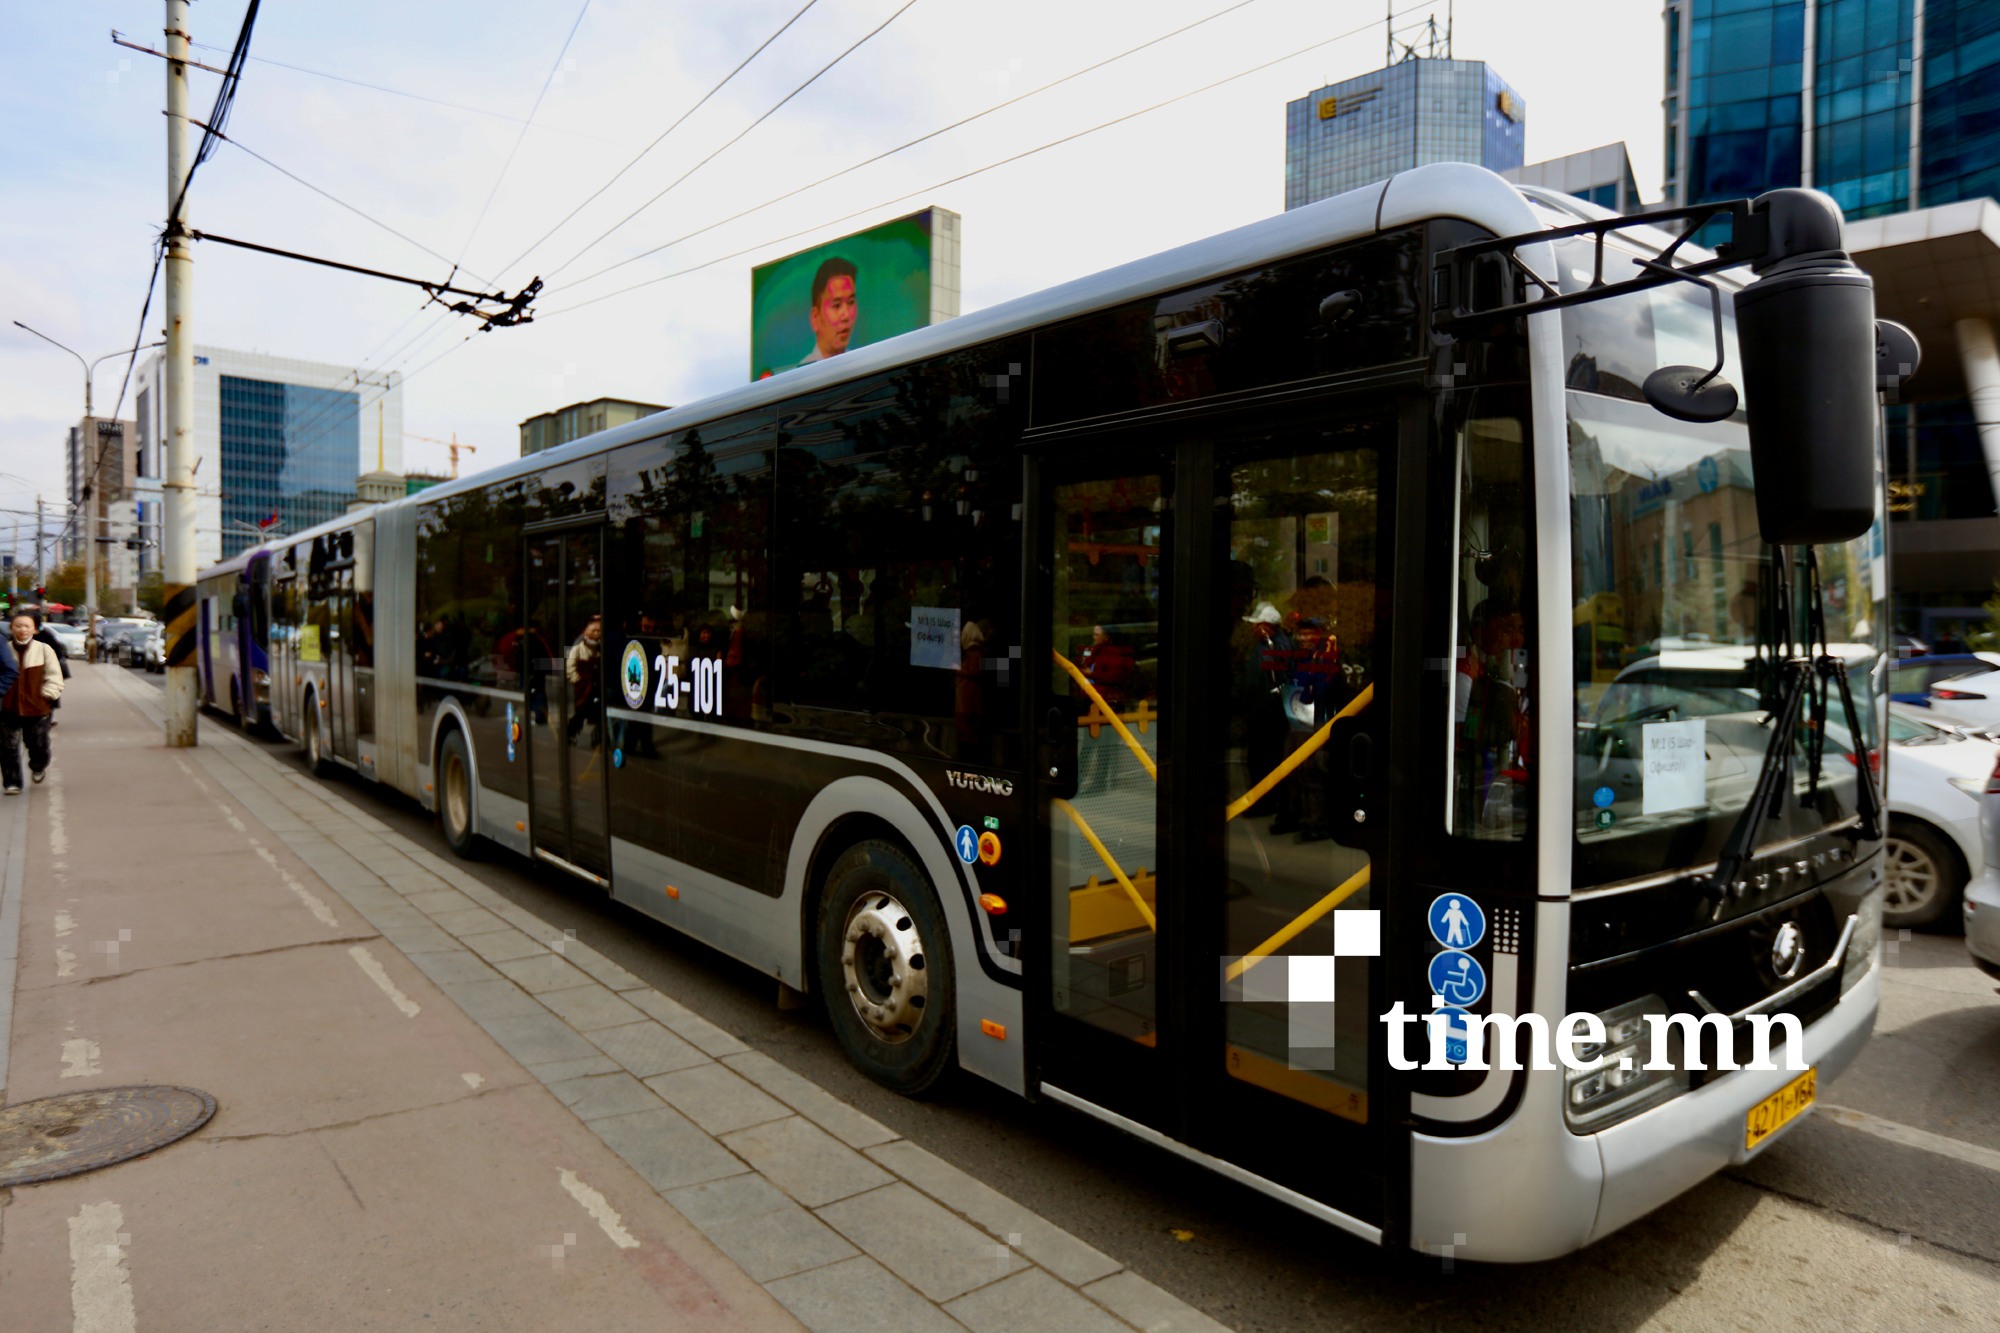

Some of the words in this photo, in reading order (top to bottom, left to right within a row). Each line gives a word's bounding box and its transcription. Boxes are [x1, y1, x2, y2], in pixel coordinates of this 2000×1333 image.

[653, 654, 723, 717] 25-101
[945, 769, 1014, 797] YUTONG
[1731, 847, 1841, 897] YUTONG
